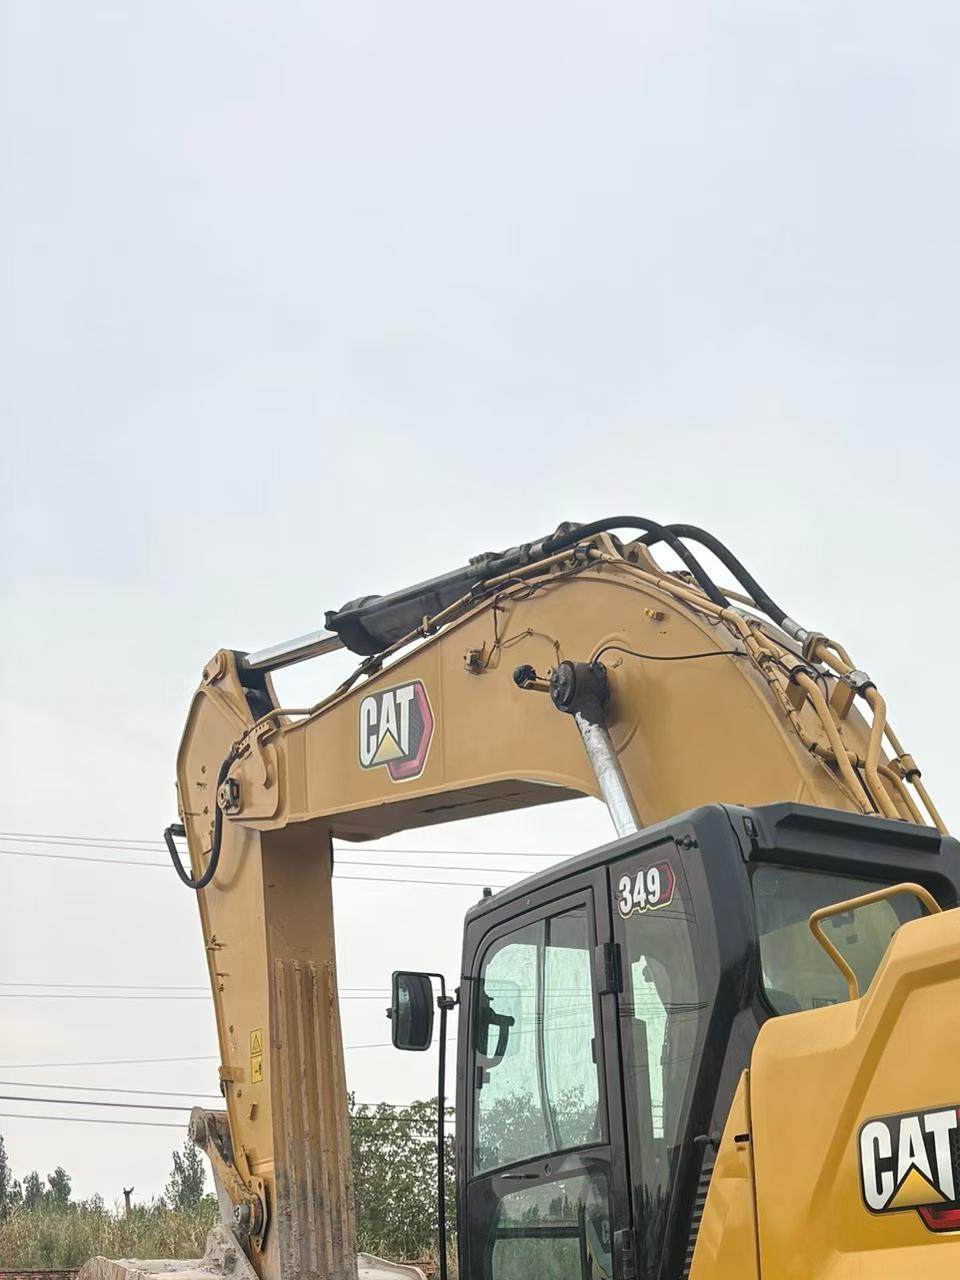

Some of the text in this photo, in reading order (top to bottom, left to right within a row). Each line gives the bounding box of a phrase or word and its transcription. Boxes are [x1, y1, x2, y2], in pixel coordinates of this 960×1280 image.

[360, 685, 415, 766] CAT
[619, 867, 661, 914] 349
[860, 1109, 958, 1210] CAT
